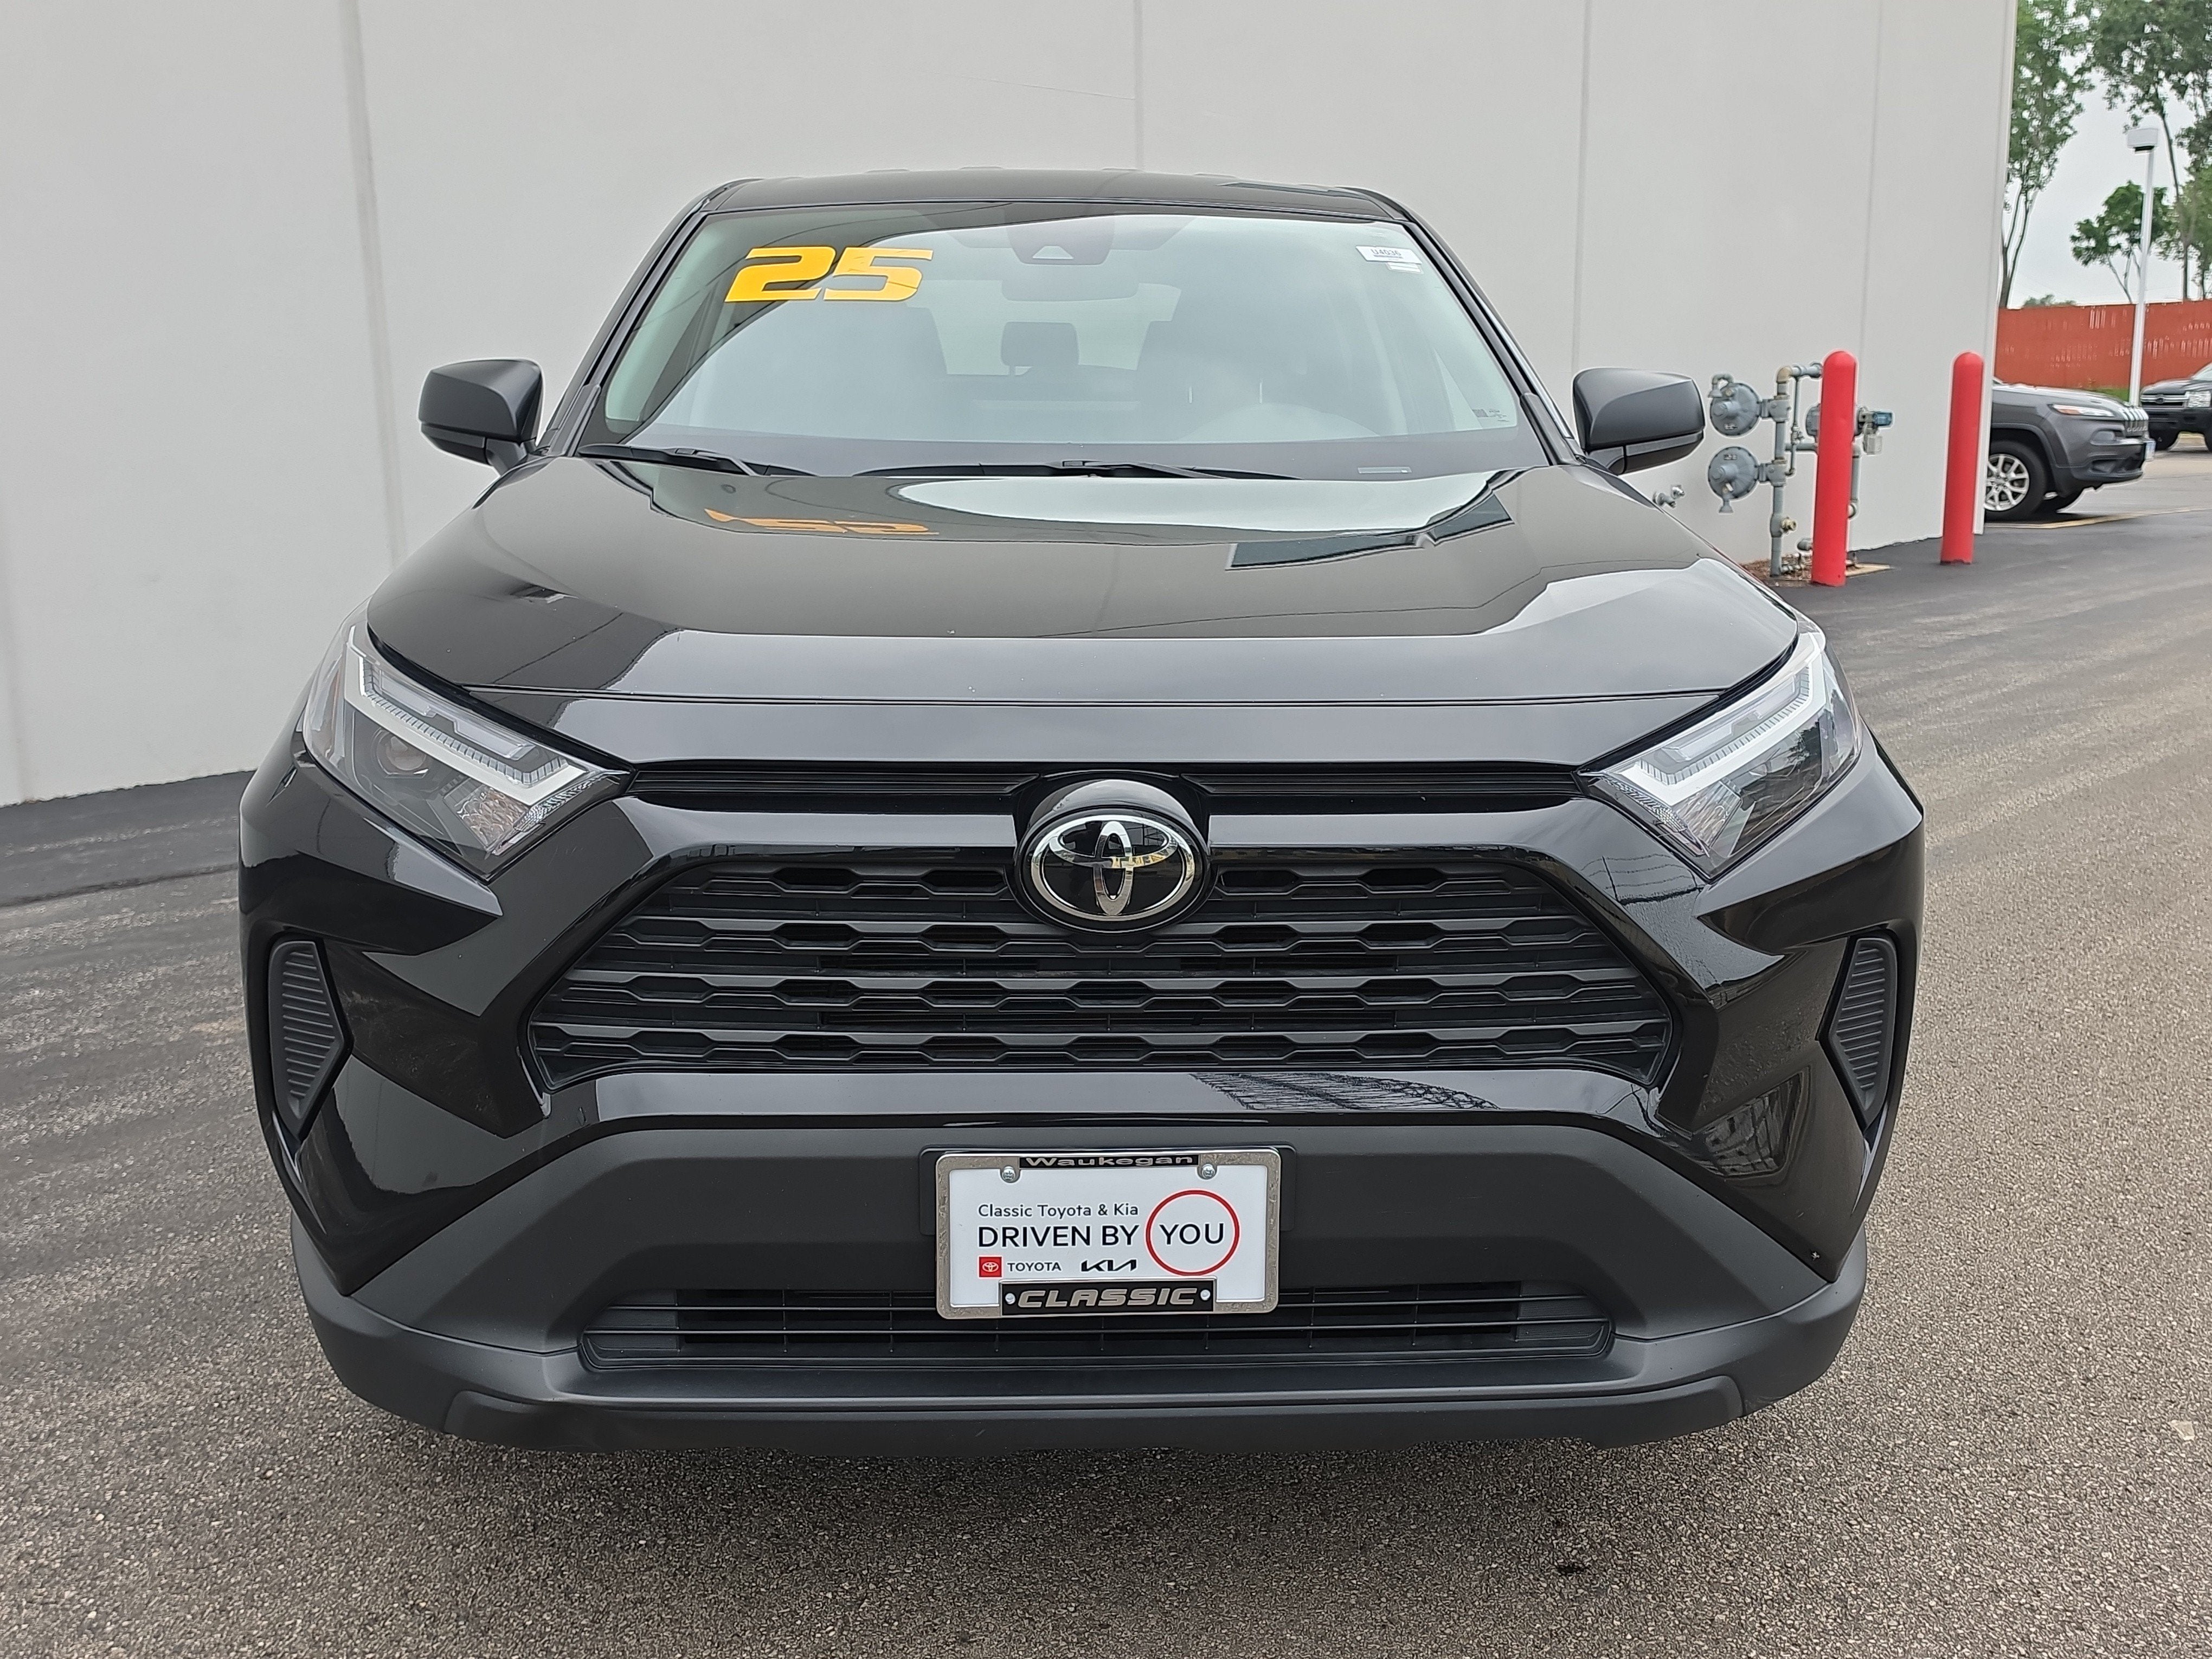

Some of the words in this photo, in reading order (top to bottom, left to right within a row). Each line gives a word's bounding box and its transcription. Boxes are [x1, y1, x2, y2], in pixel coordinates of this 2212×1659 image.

[724, 246, 934, 302] 25
[1026, 1156, 1193, 1166] Waukegan
[978, 1204, 1032, 1217] Classic
[1037, 1204, 1091, 1220] Toyota
[1097, 1204, 1108, 1216] &
[1114, 1203, 1139, 1216] Kia
[979, 1226, 1091, 1248] DRIVEN
[1102, 1225, 1140, 1246] BY
[1159, 1223, 1224, 1245] YOU
[1007, 1262, 1062, 1272] TOYOTA
[1081, 1259, 1137, 1272] KIA
[1017, 1288, 1198, 1308] CLASSIC
